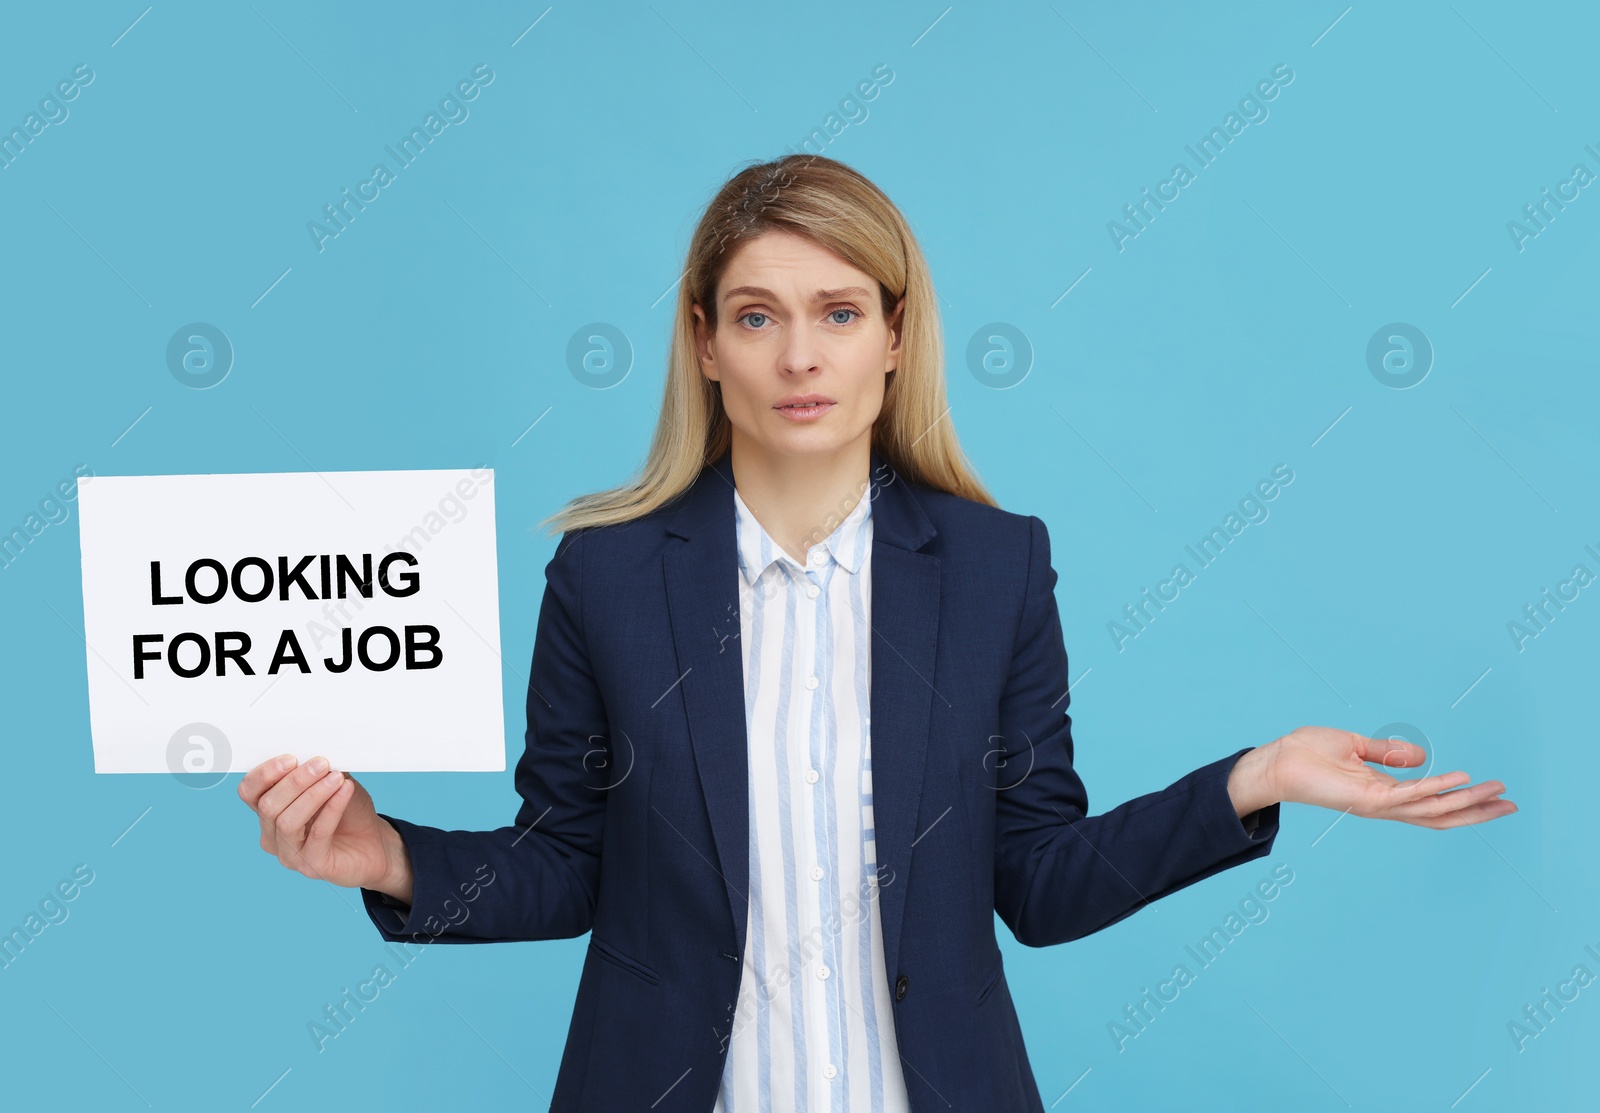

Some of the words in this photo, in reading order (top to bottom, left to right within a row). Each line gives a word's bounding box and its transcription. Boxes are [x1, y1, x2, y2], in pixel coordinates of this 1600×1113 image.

[150, 552, 421, 607] LOOKING
[133, 632, 256, 680] FOR
[268, 630, 312, 676] A
[324, 625, 444, 675] JOB
